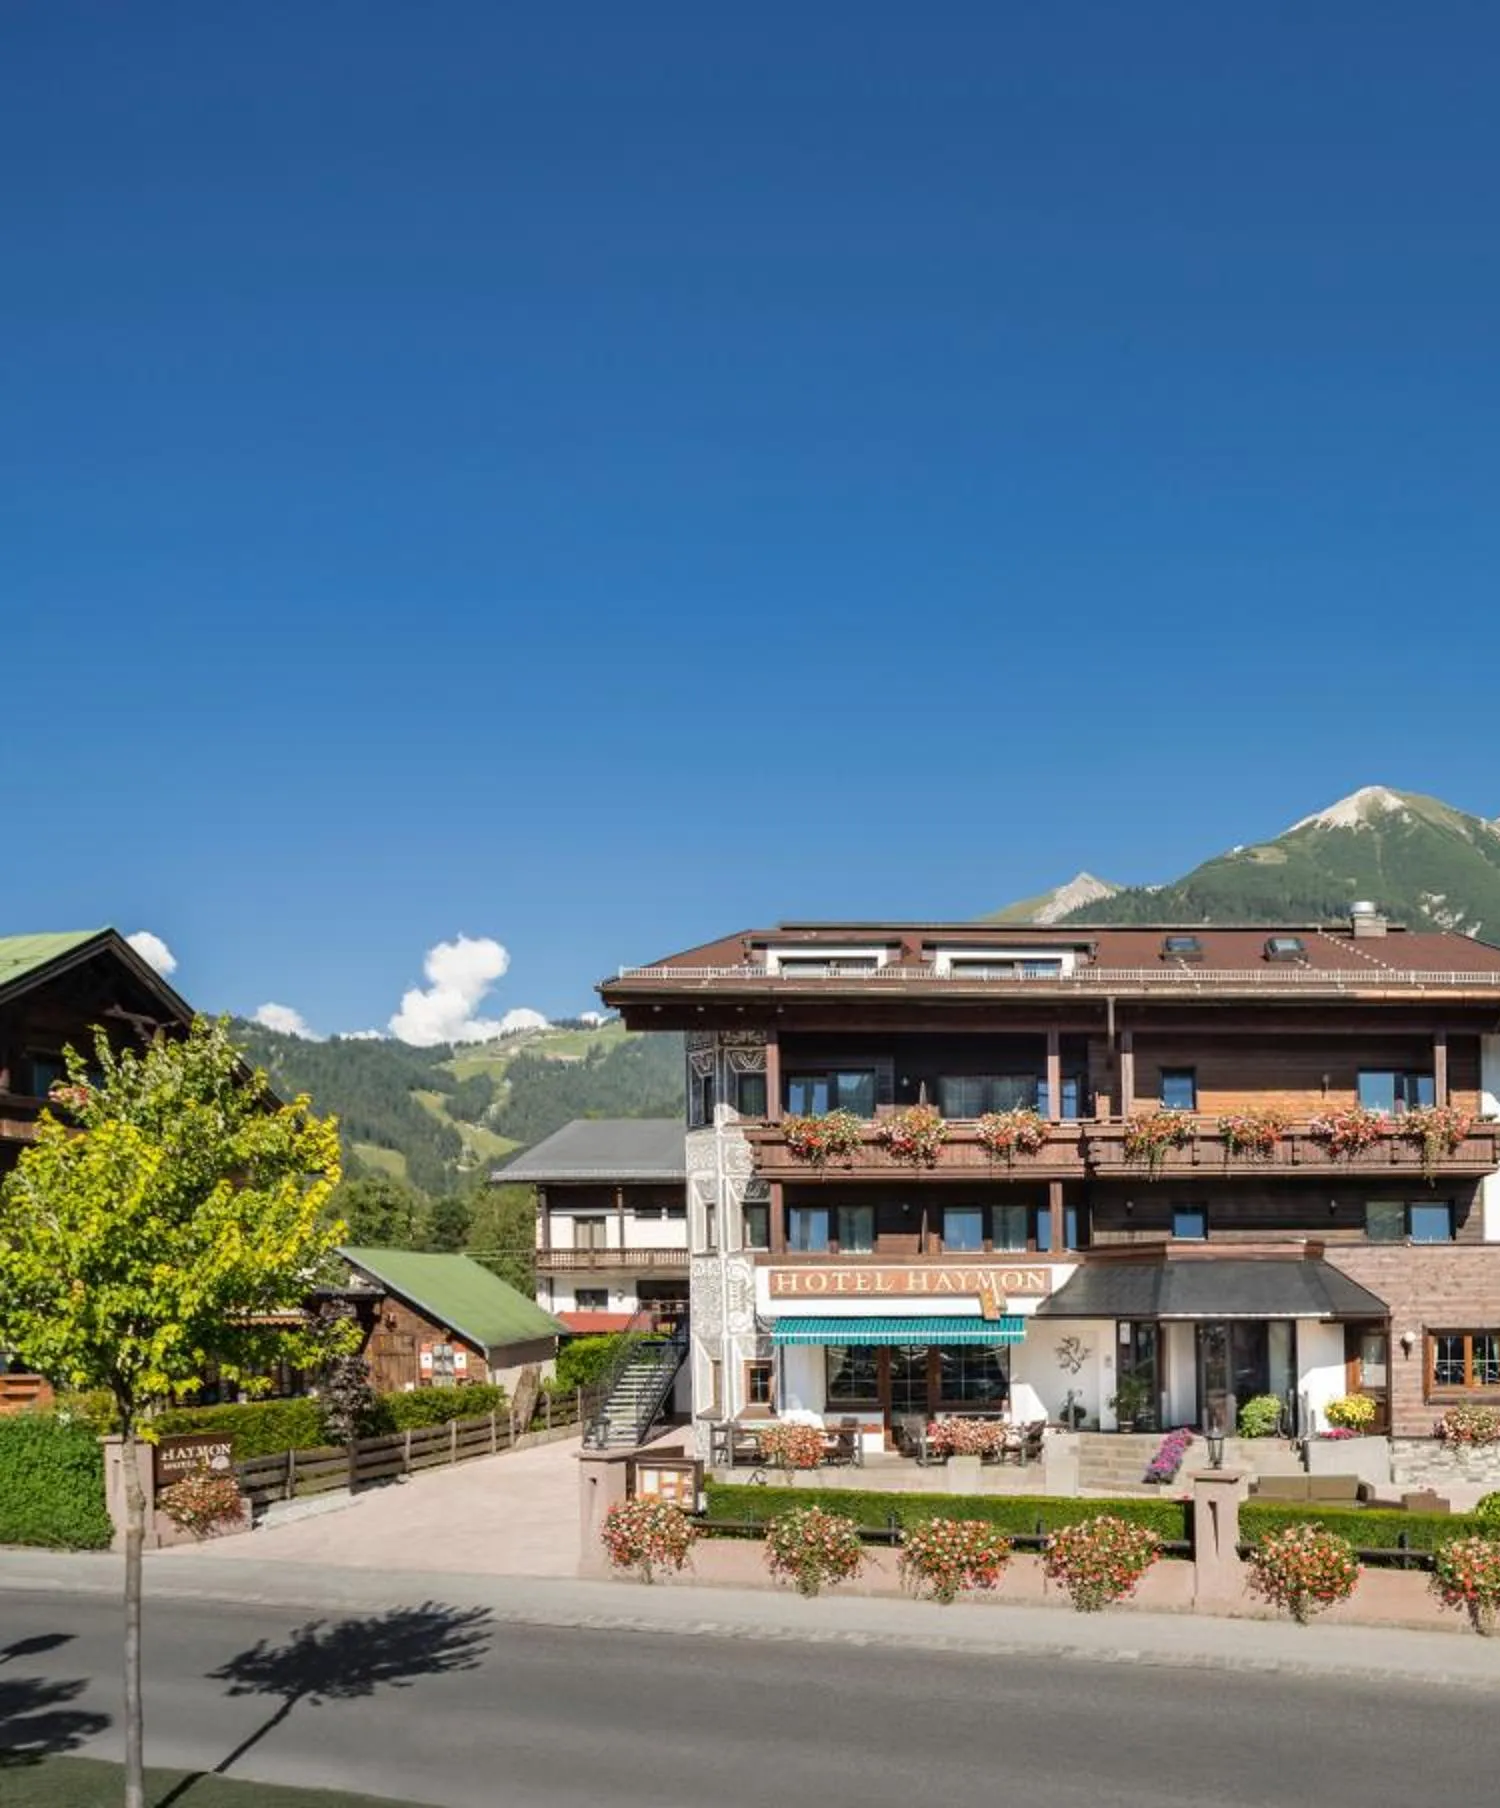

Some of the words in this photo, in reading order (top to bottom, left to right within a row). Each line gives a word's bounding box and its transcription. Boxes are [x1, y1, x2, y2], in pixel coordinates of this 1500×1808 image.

[775, 1272, 895, 1292] HOTEL
[904, 1270, 1045, 1305] HAYMON
[160, 1443, 232, 1465] HAYMON
